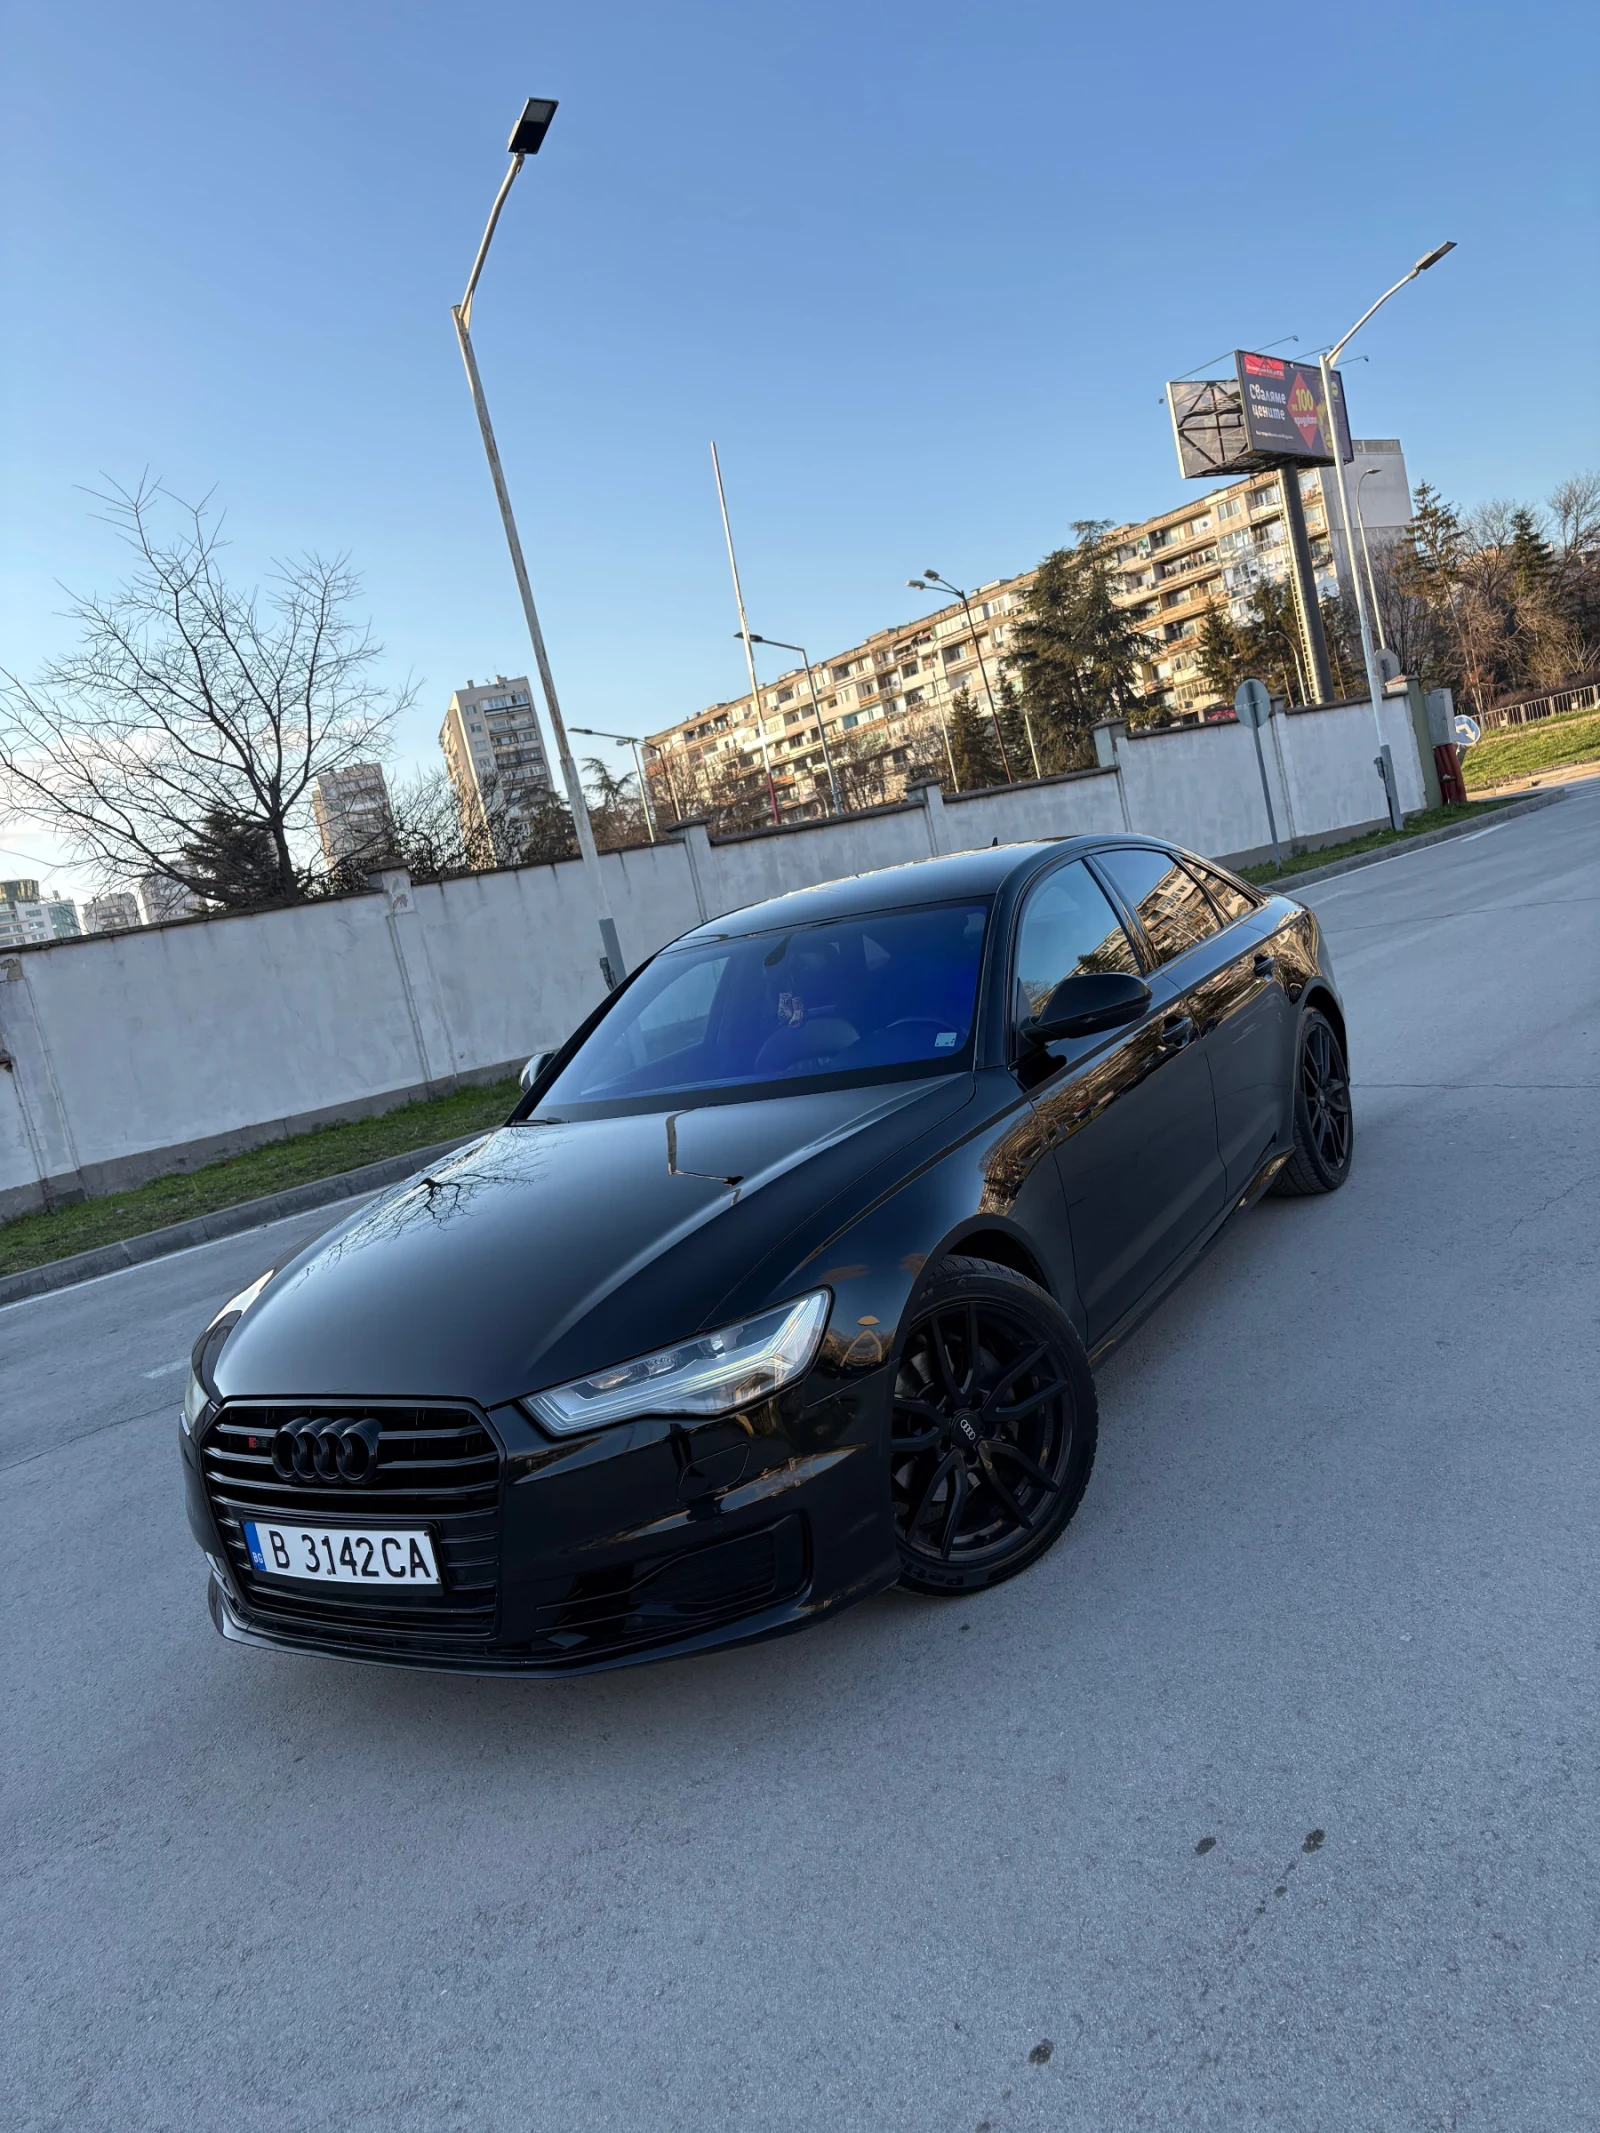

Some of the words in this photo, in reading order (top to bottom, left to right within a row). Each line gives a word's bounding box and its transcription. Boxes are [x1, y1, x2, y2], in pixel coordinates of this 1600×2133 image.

[1249, 383, 1286, 405] Сваляме
[1295, 388, 1314, 412] 100
[1252, 404, 1286, 421] цените
[252, 1552, 264, 1563] BG
[268, 1530, 290, 1569] B
